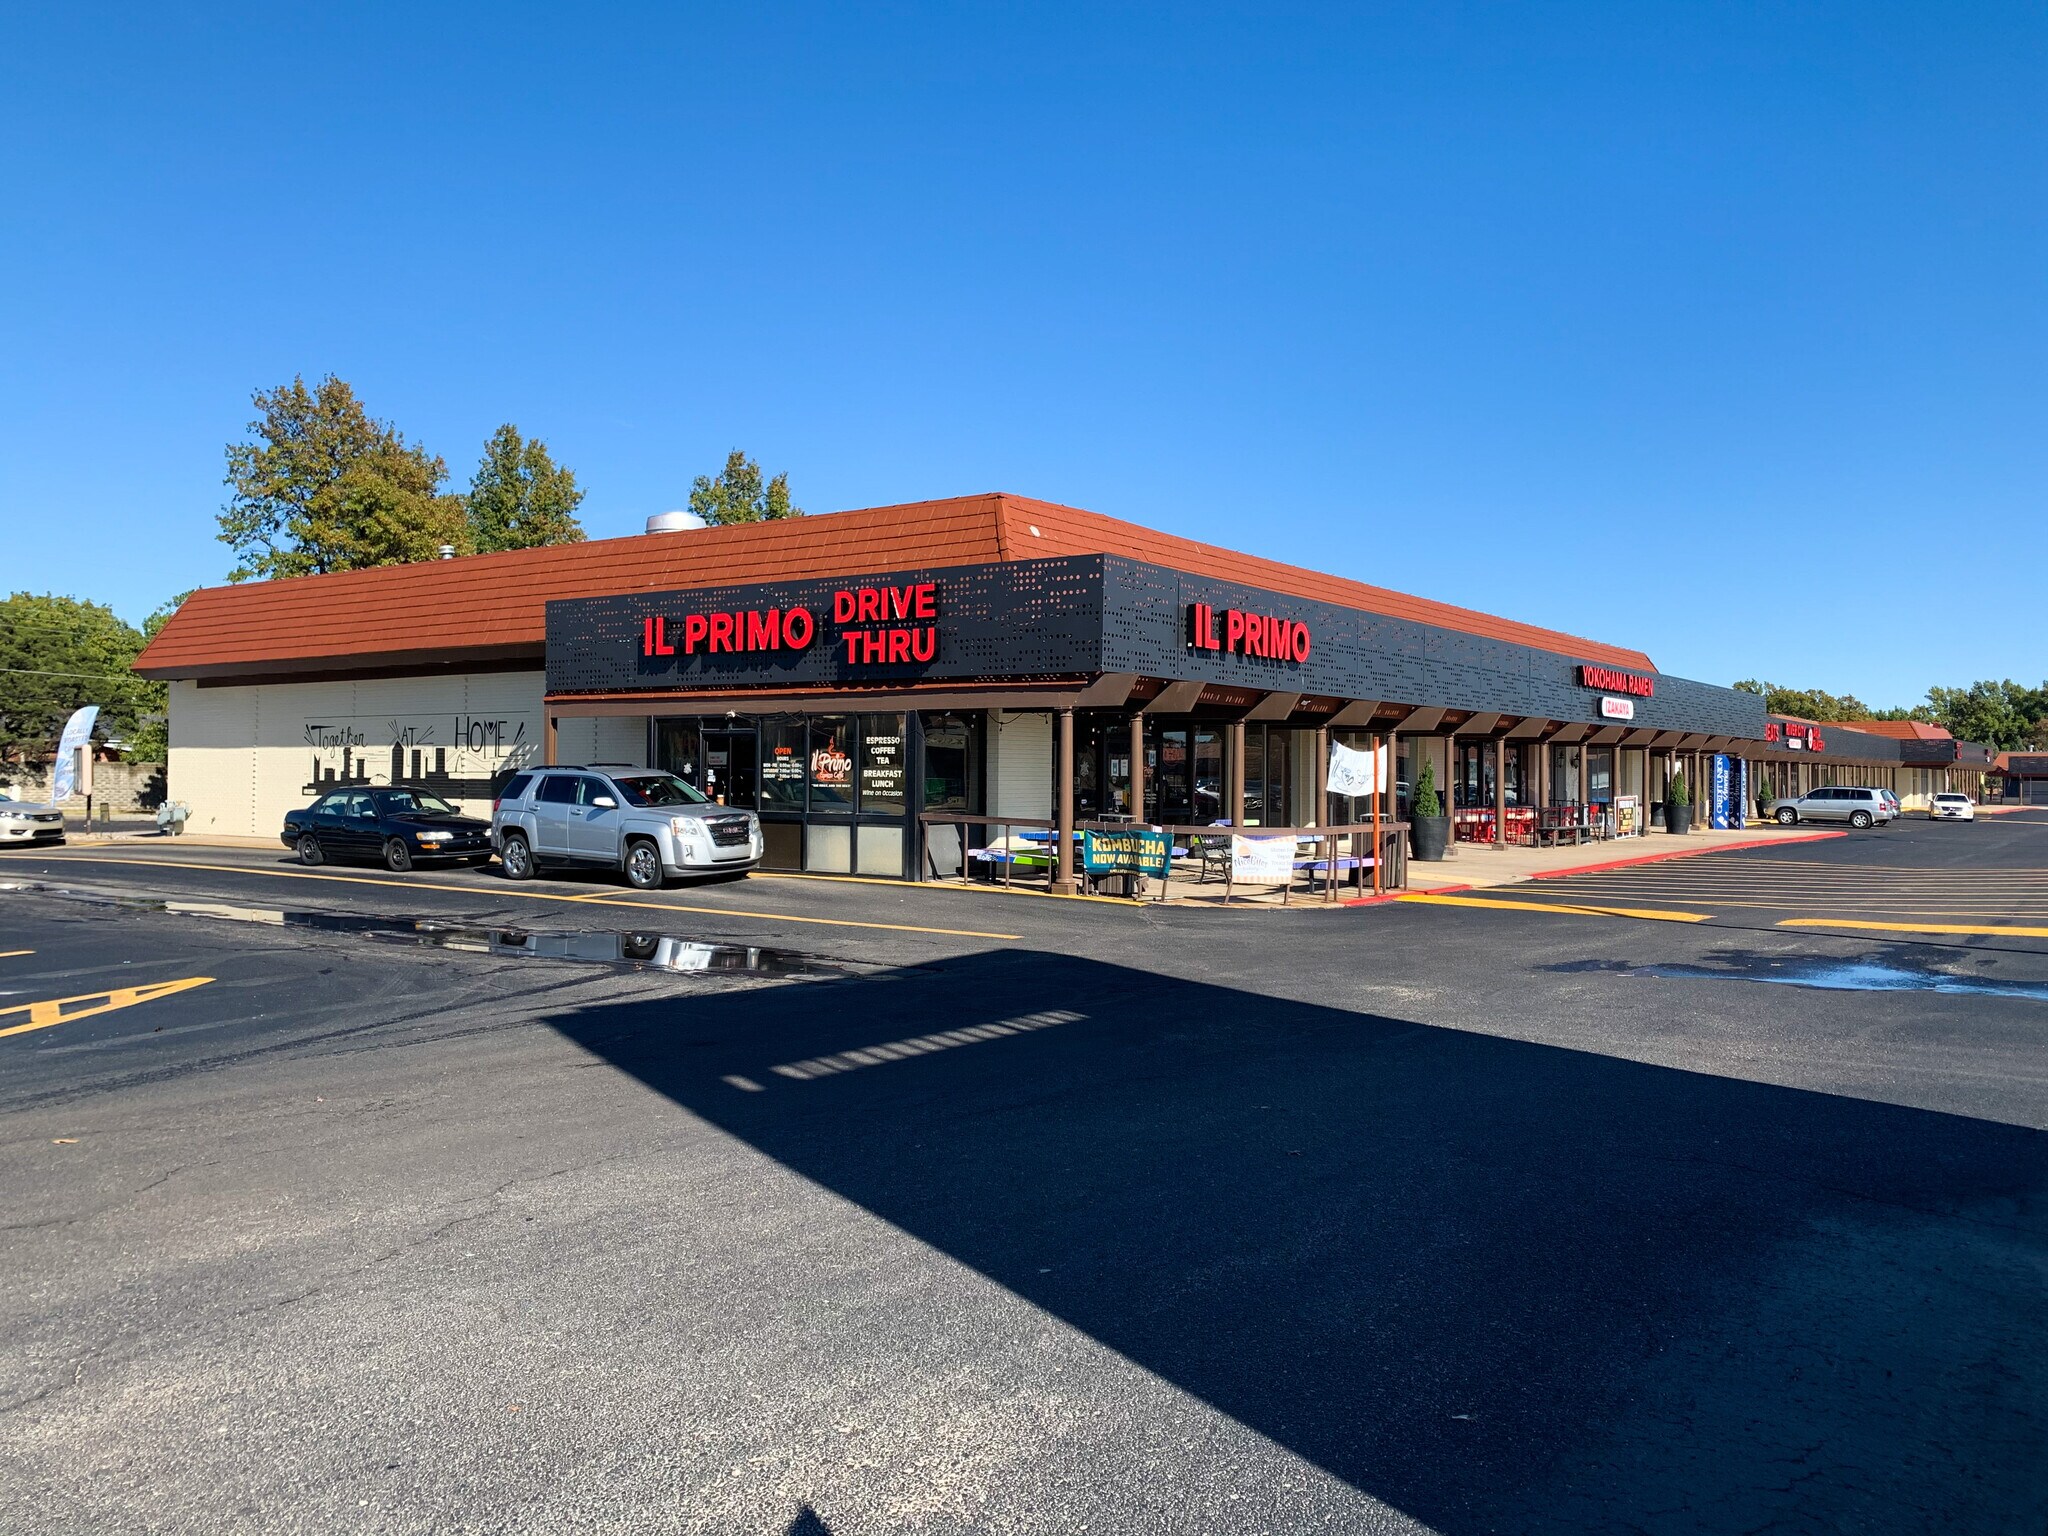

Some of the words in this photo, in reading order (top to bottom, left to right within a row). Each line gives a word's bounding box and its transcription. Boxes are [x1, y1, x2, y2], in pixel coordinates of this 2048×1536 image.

[834, 583, 936, 624] DRIVE
[644, 616, 675, 656] IL
[685, 607, 814, 654] PRIMO
[1195, 603, 1220, 650] IL
[1228, 609, 1311, 663] PRIMO
[842, 627, 936, 664] THRU
[1582, 665, 1628, 693] YOKOHAMA
[1628, 674, 1655, 697] RAMEN
[1605, 700, 1630, 716] IZAKAYA
[310, 725, 368, 759] Together
[401, 725, 419, 748] AT
[455, 716, 508, 759] HOME
[866, 736, 901, 745] ESPRESSO
[774, 747, 792, 755] OPEN
[870, 746, 896, 755] COFFEE
[876, 756, 890, 765] TEA
[863, 769, 903, 778] BREAKFAST
[871, 780, 894, 788] LUNCH
[1092, 837, 1166, 856] KOMBUCHA
[1092, 853, 1116, 864] NOW
